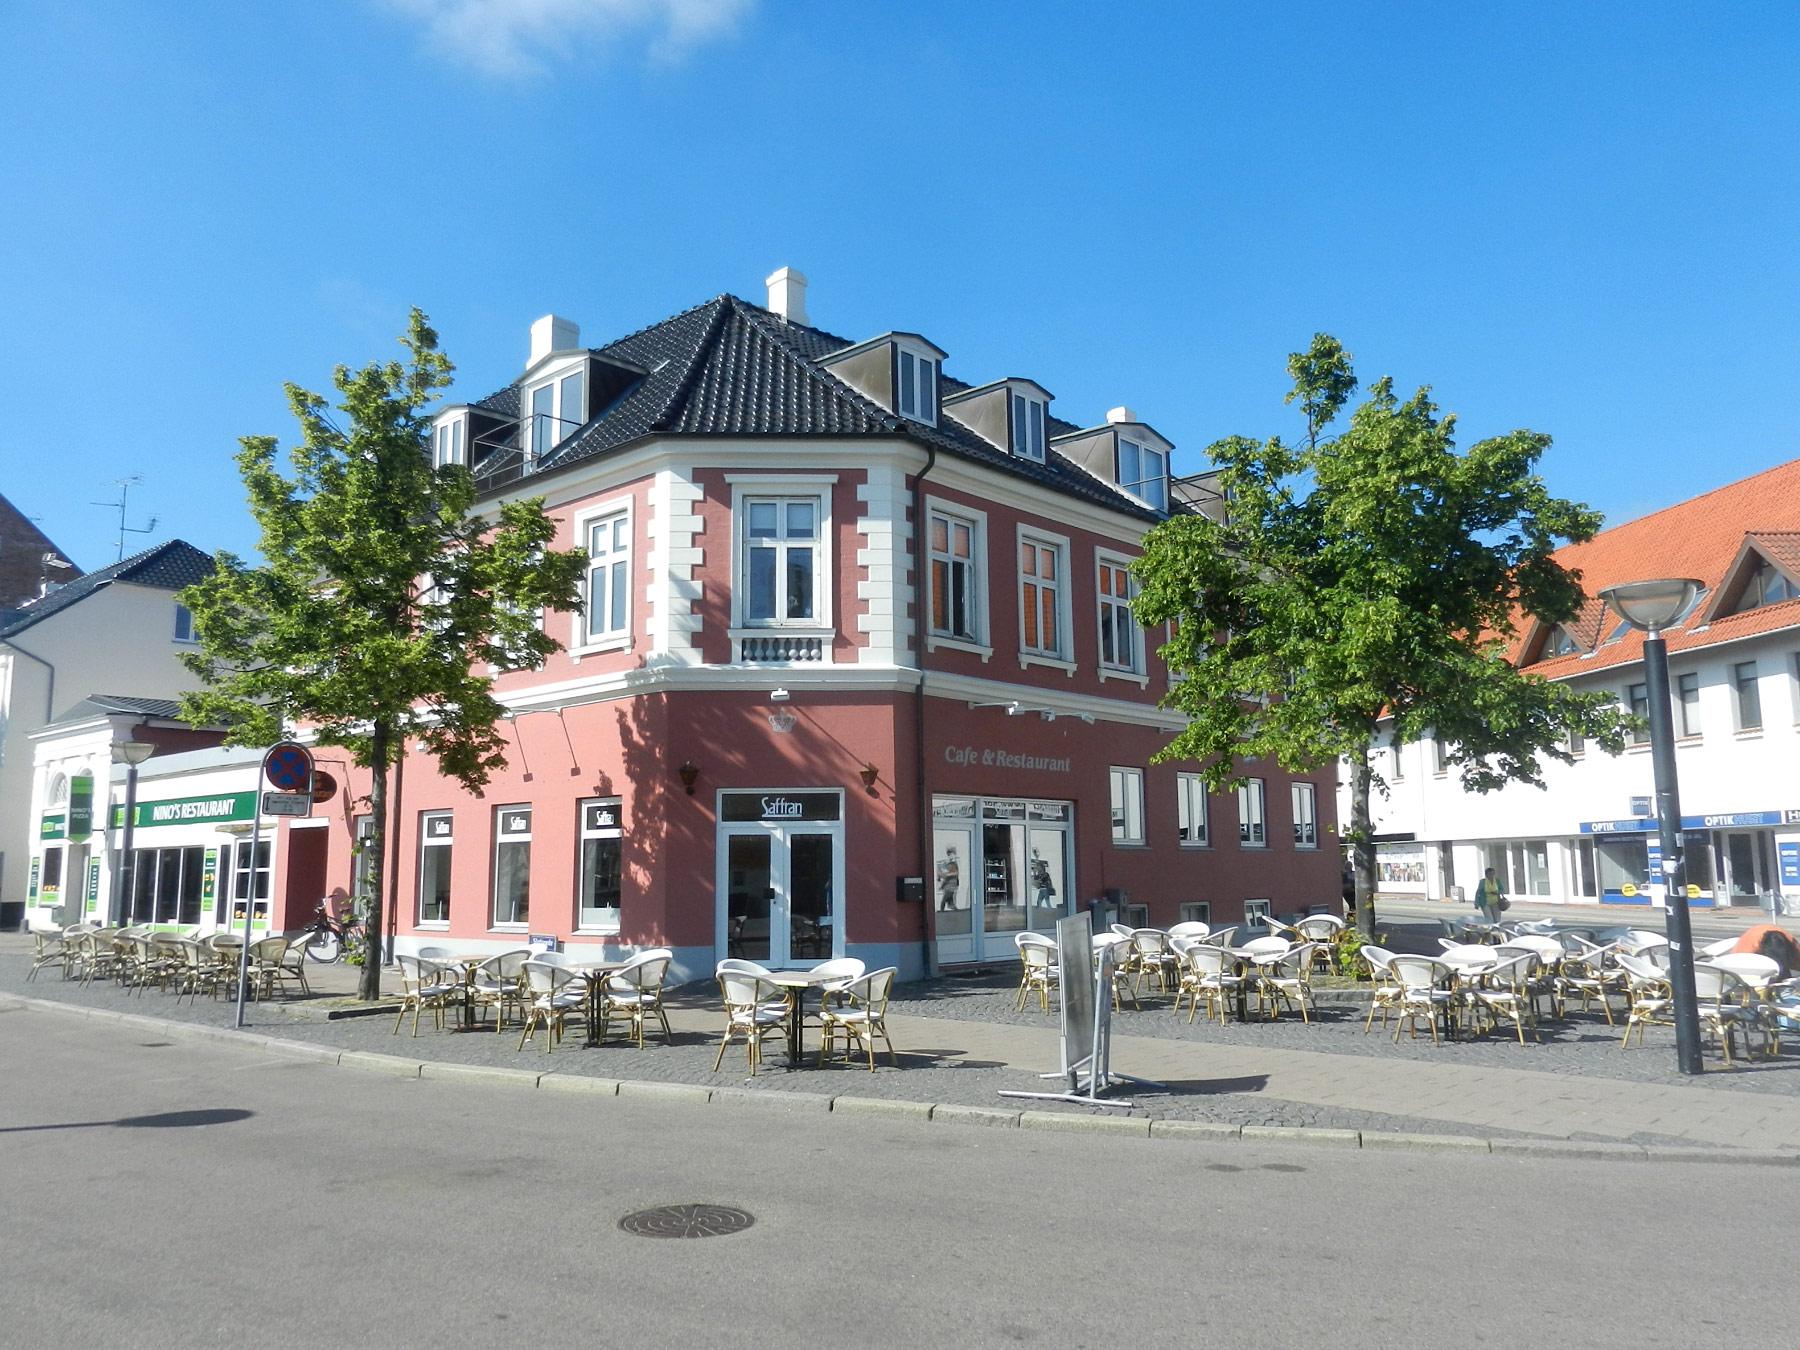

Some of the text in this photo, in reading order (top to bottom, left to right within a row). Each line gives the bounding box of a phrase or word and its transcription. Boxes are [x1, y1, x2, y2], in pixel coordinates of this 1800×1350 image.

[945, 746, 1071, 772] Cafe & Restaurant
[153, 803, 181, 820] NINO'S
[181, 799, 236, 818] RESTAURANT
[761, 797, 803, 818] Saffran
